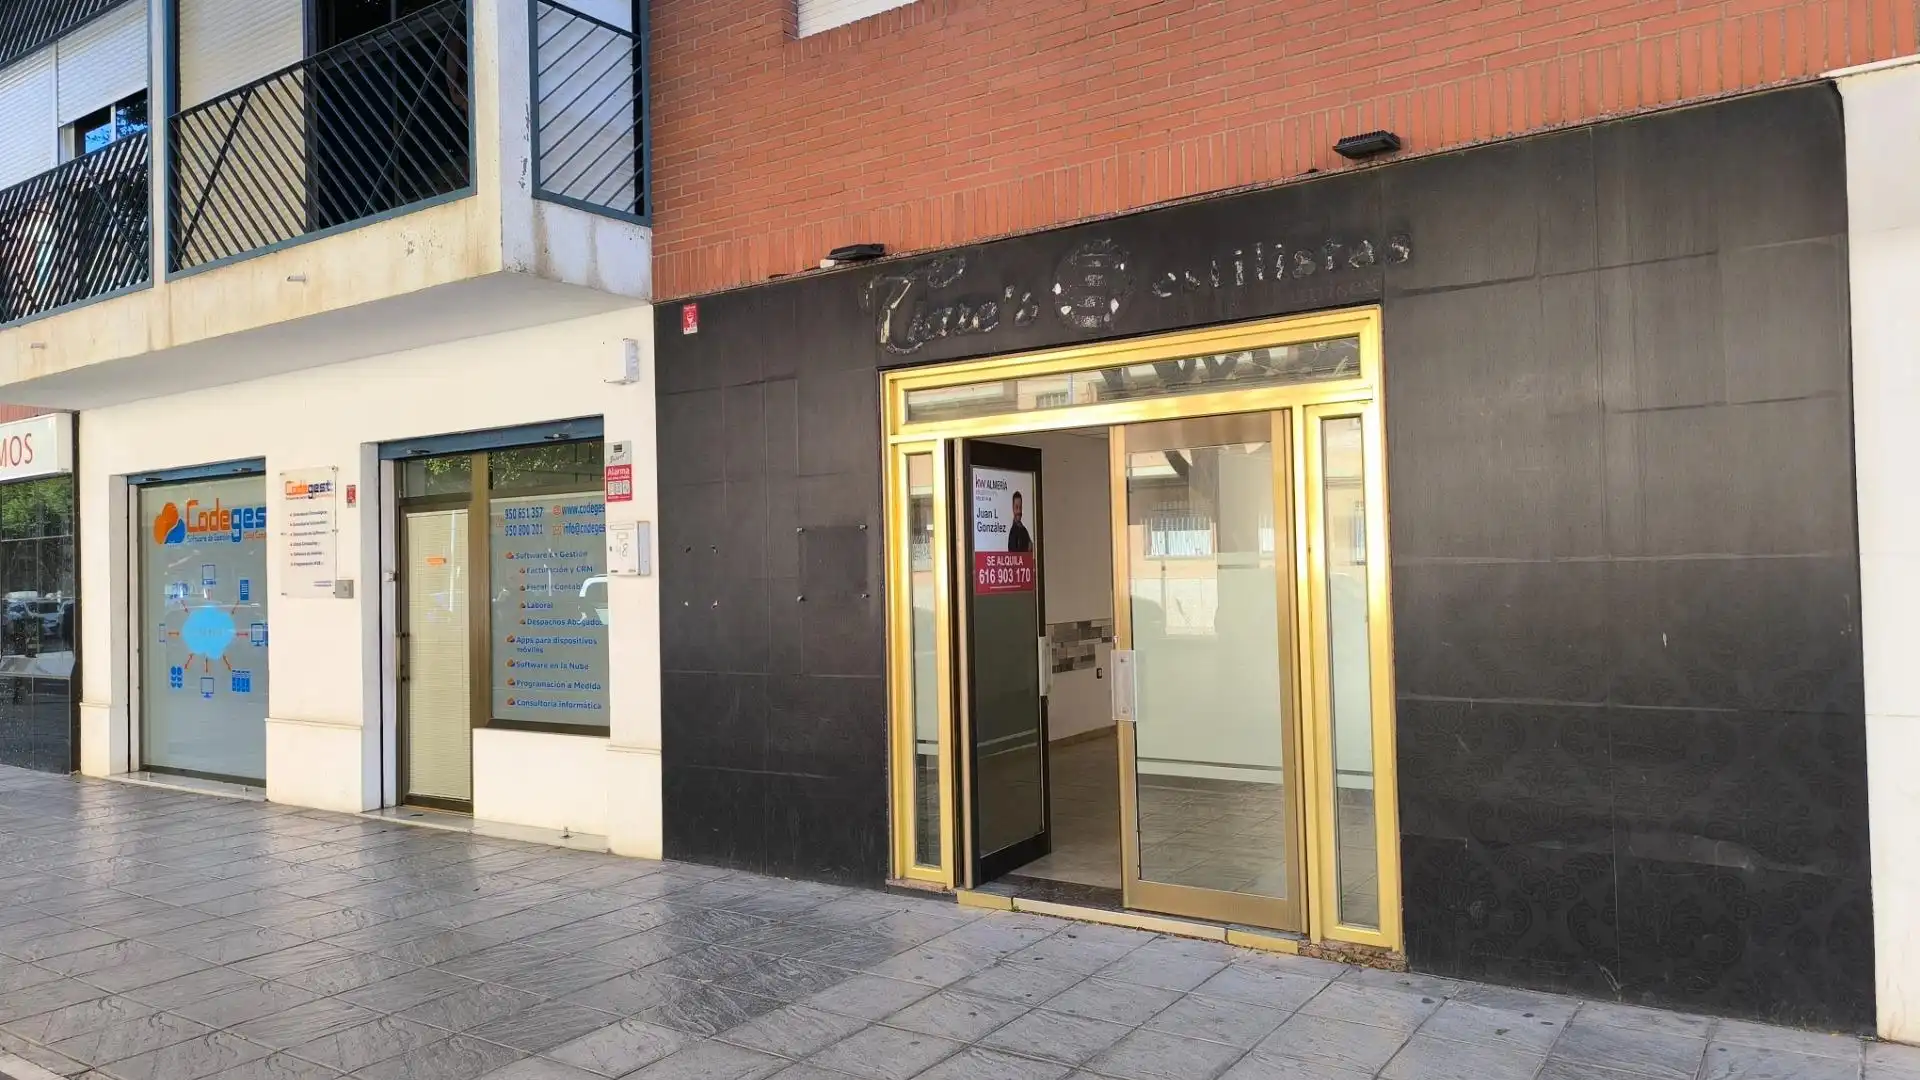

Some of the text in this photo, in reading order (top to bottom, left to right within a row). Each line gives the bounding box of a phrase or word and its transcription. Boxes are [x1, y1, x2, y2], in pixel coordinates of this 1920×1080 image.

[505, 508, 516, 519] 950
[531, 507, 544, 518] 357
[977, 508, 993, 519] Juan
[186, 498, 267, 543] Codeges
[505, 525, 517, 536] 950
[977, 521, 1006, 533] González
[515, 551, 547, 560] Software
[559, 550, 588, 559] Gestión
[986, 555, 1024, 567] SE ALQUILA
[576, 564, 593, 573] CRM
[979, 567, 1031, 584] 616 903 170
[527, 601, 553, 609] Laboral
[527, 618, 565, 627] Despachos
[516, 635, 597, 646] Apps para dispositivos
[517, 645, 544, 653] móviles
[516, 661, 548, 669] Software
[560, 661, 568, 669] la
[569, 661, 589, 670] Nube
[516, 679, 566, 689] Programación
[574, 681, 602, 690] Medida
[517, 698, 557, 708] Consultoría
